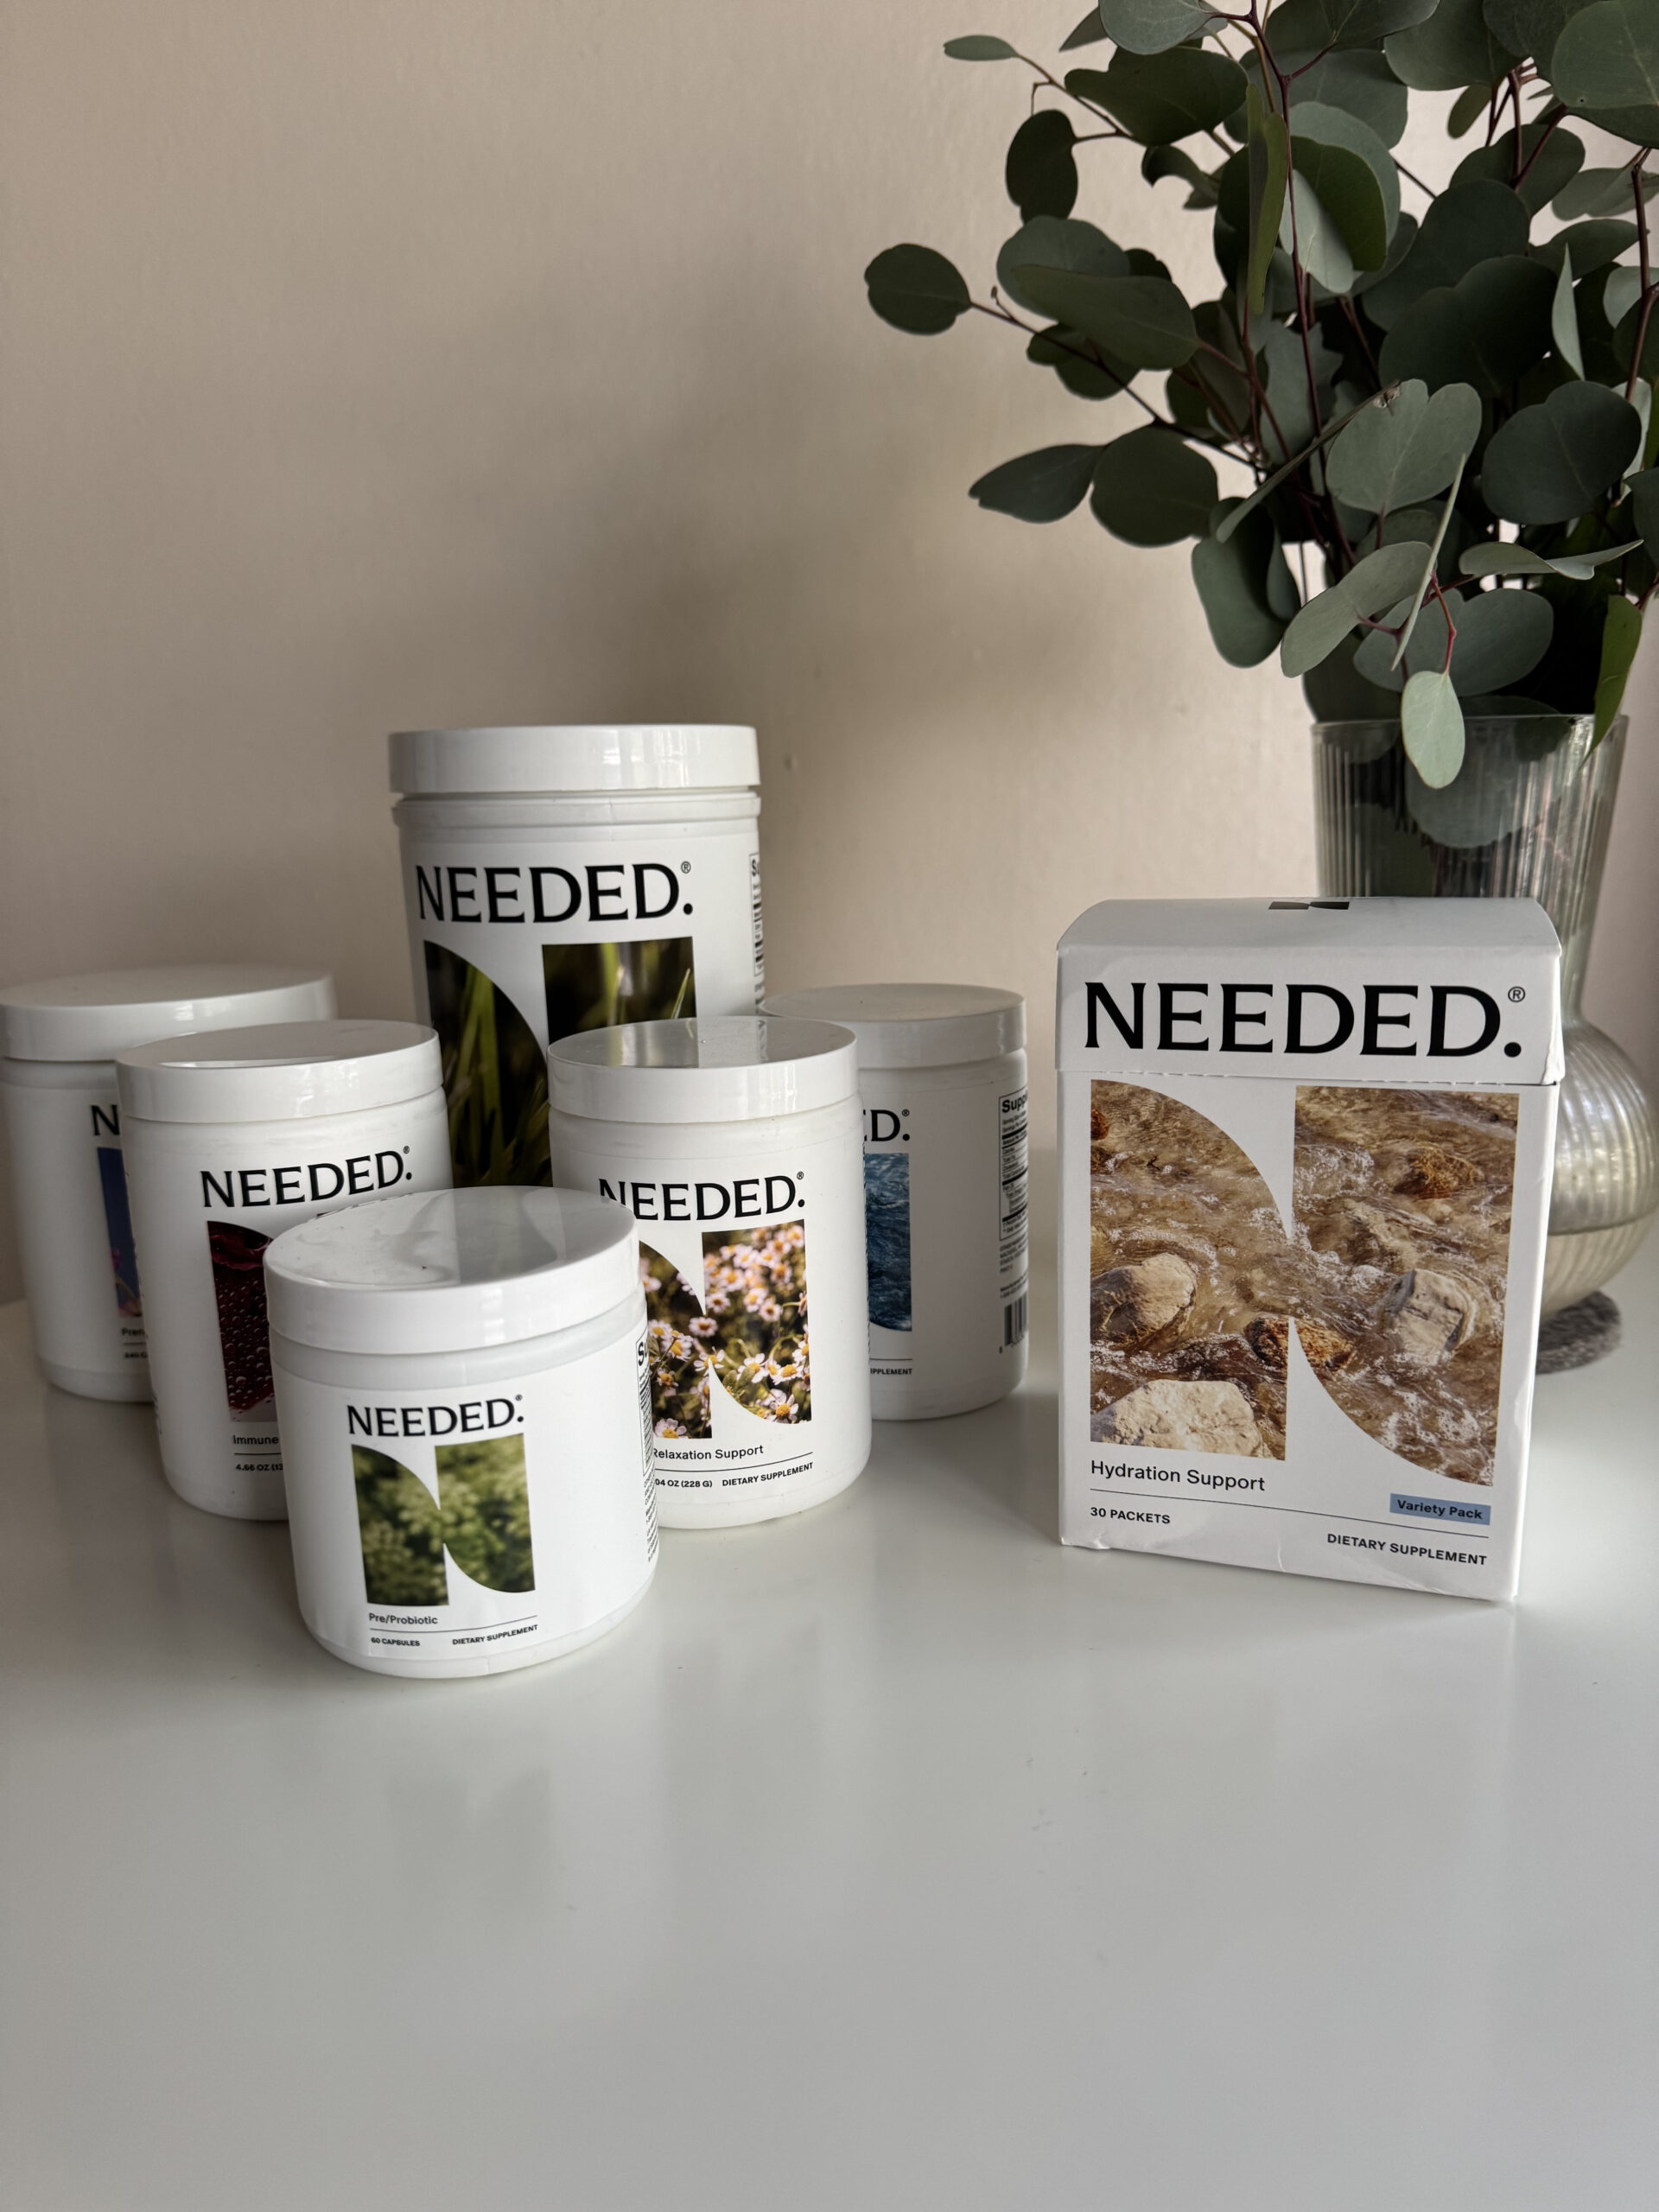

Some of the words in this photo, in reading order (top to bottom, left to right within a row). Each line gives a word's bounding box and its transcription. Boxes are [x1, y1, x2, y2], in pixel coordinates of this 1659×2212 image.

[232, 1434, 279, 1446] Immune
[715, 1445, 764, 1460] Support
[721, 1475, 759, 1487] DIETARY
[760, 1461, 814, 1483] SUPPLEMENT
[1090, 1459, 1181, 1483] Hydration
[1186, 1469, 1266, 1491] Support
[681, 1480, 701, 1489] (228
[702, 1480, 713, 1489] G)
[1090, 1506, 1107, 1518] 30
[1109, 1509, 1171, 1524] PACKETS
[1396, 1498, 1446, 1517] Variety
[1448, 1506, 1483, 1520] Pack
[1326, 1533, 1386, 1552] DIETARY
[1389, 1542, 1487, 1566] SUPPLEMENT
[368, 1612, 439, 1625] Pre/Probiotic
[382, 1637, 421, 1647] CAPSULES
[451, 1636, 486, 1645] DIETARY
[486, 1624, 538, 1641] SUPPLEMENT
